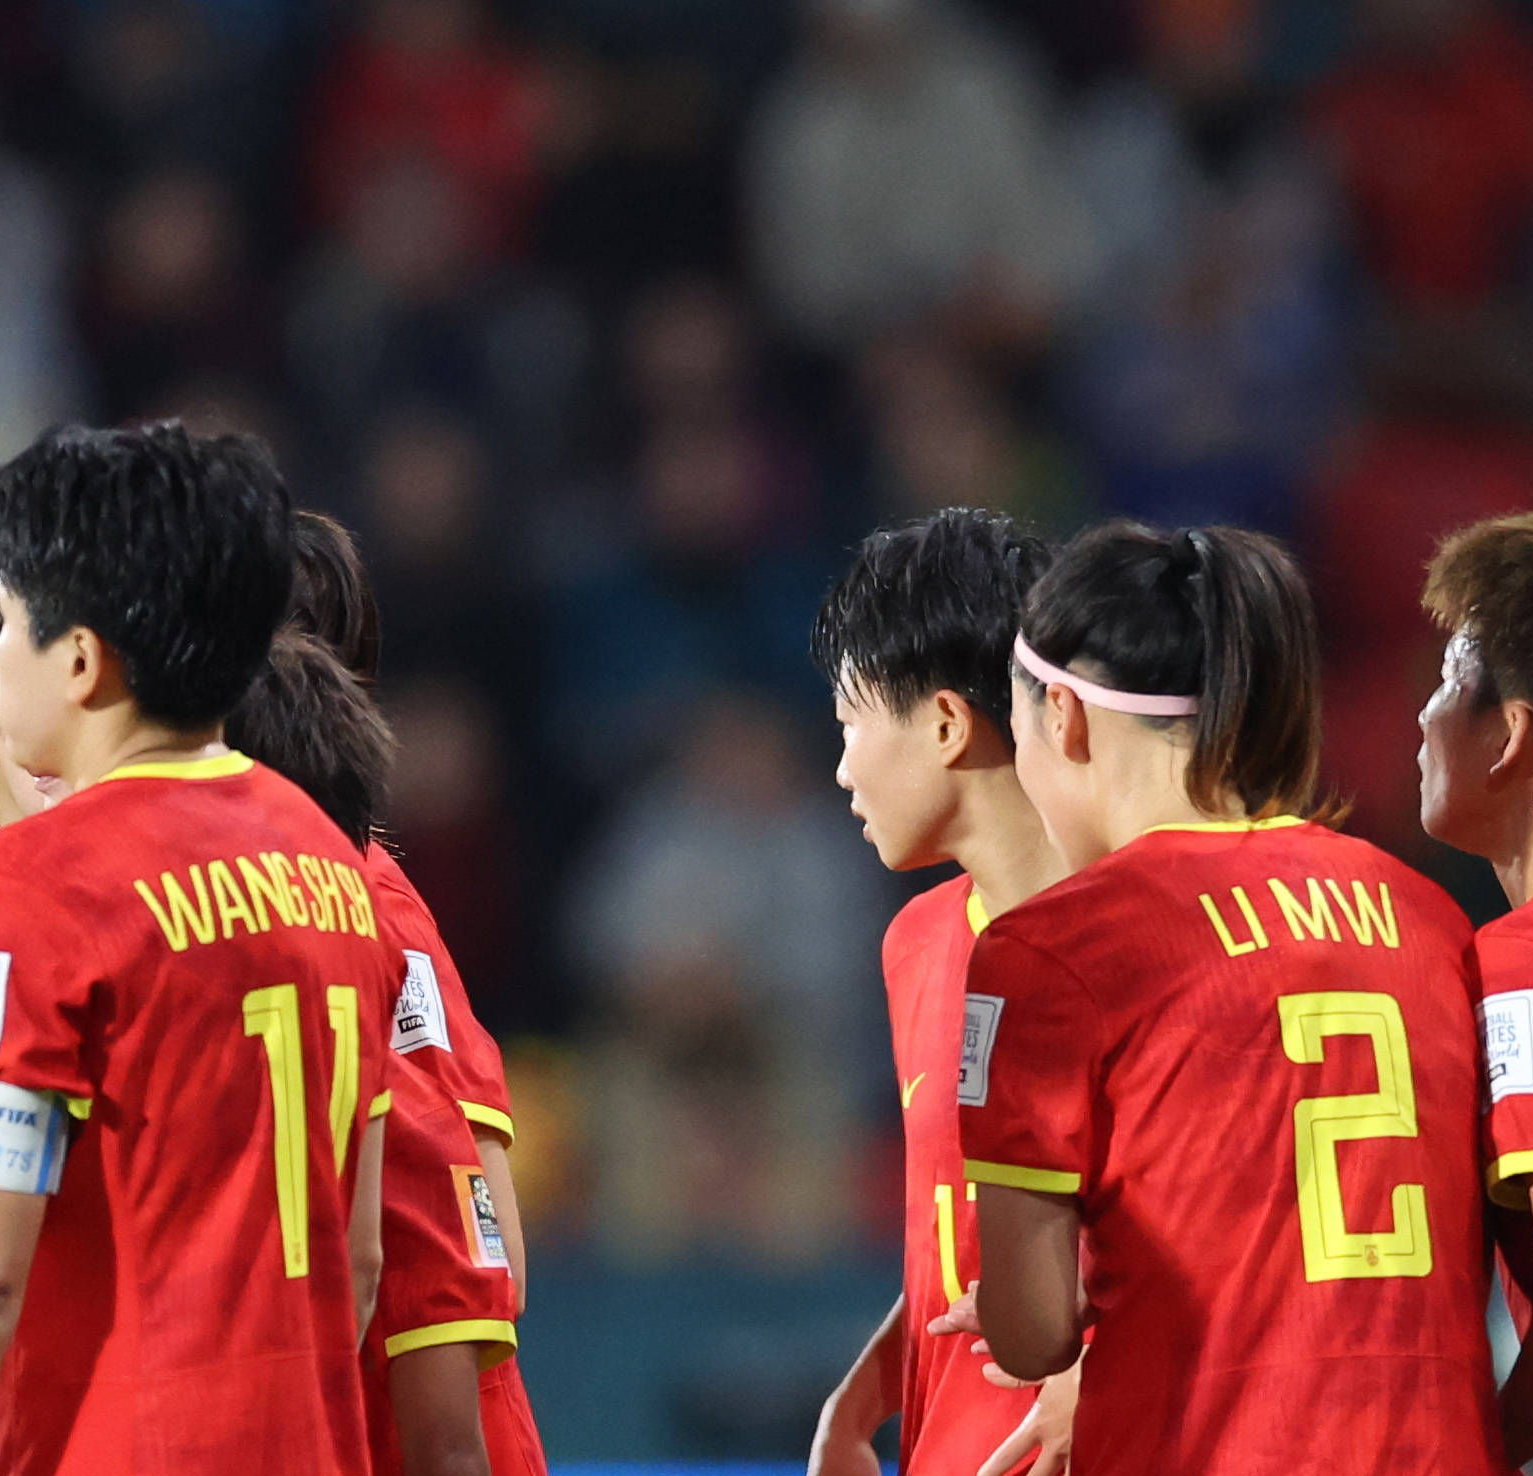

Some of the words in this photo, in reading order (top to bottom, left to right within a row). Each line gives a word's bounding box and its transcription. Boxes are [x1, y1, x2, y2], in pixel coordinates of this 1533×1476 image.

[1198, 885, 1270, 958] LI
[1266, 877, 1400, 949] MW
[402, 1016, 424, 1030] FIFA
[242, 983, 360, 1279] 11
[1277, 991, 1433, 1283] 2
